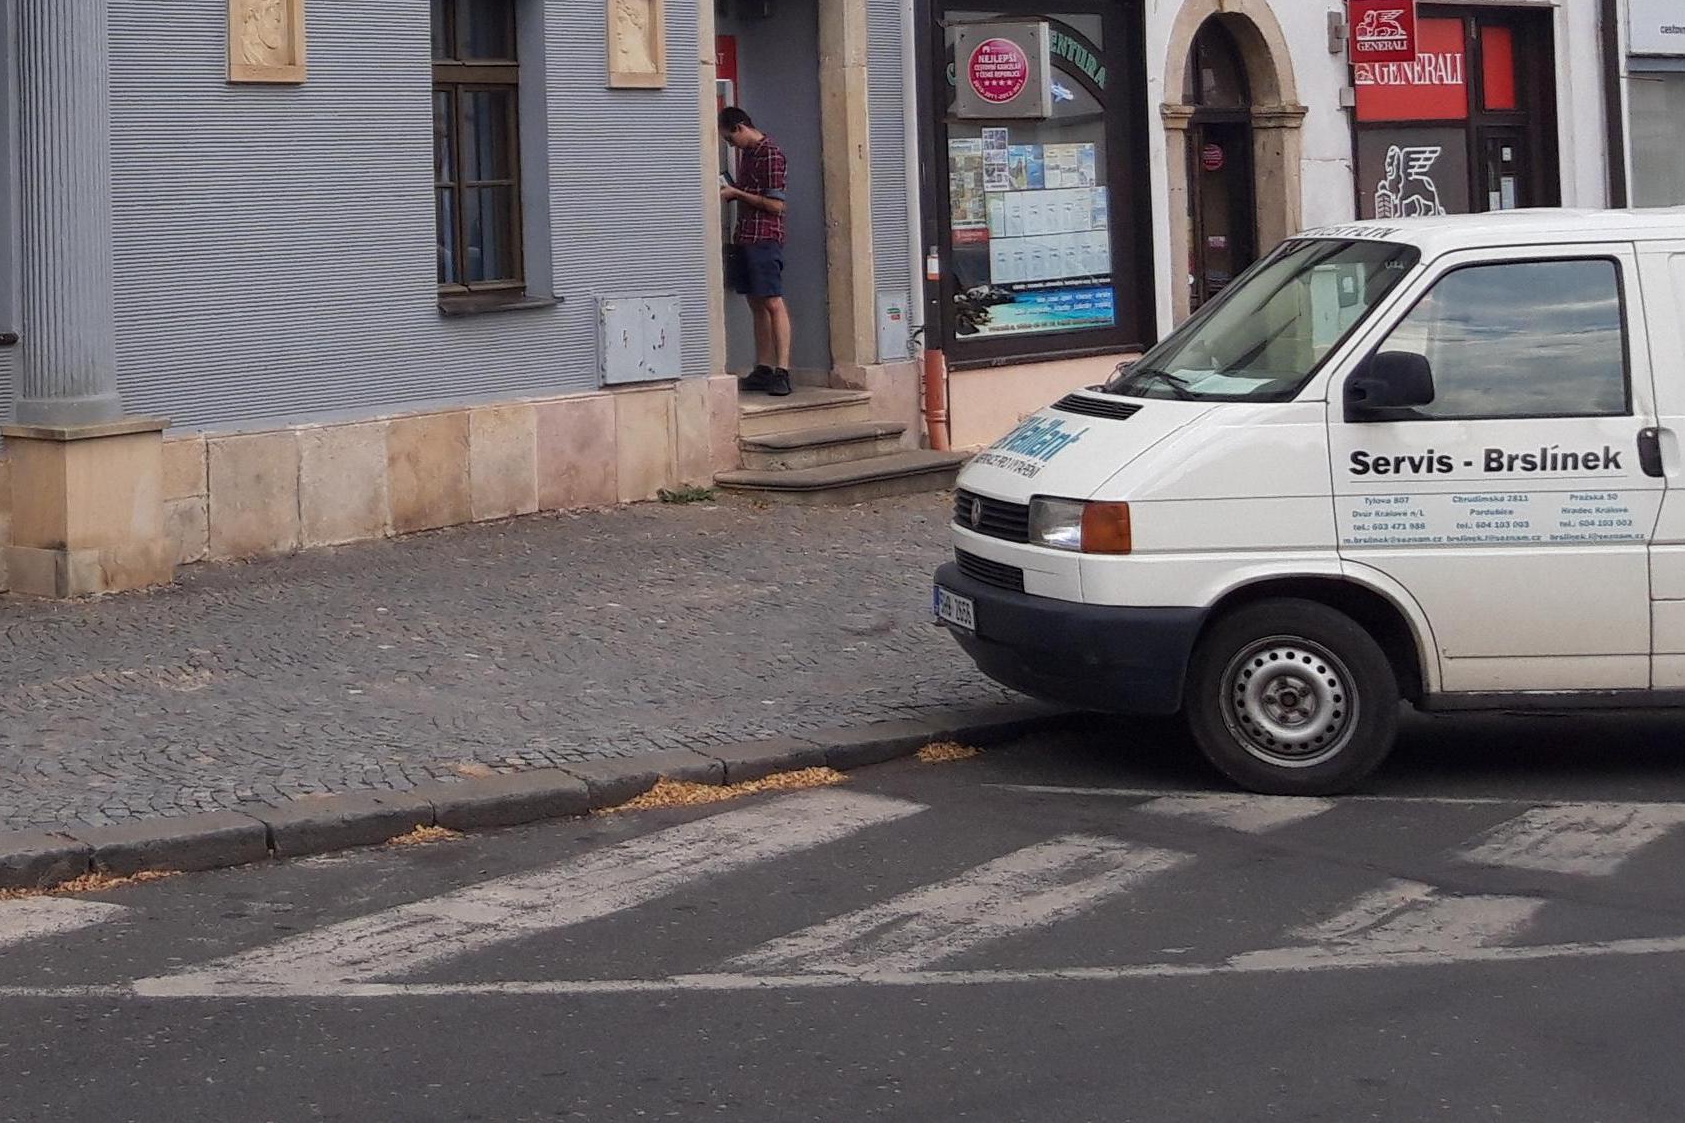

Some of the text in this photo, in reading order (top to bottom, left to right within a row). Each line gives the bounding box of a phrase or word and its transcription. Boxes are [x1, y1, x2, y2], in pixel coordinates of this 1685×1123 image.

[1356, 40, 1408, 52] GENERALI
[978, 53, 1017, 64] NEJLEPŠÍ
[1375, 52, 1463, 86] GENERALI
[1349, 449, 1454, 475] Servis
[1483, 445, 1623, 473] Brslínek
